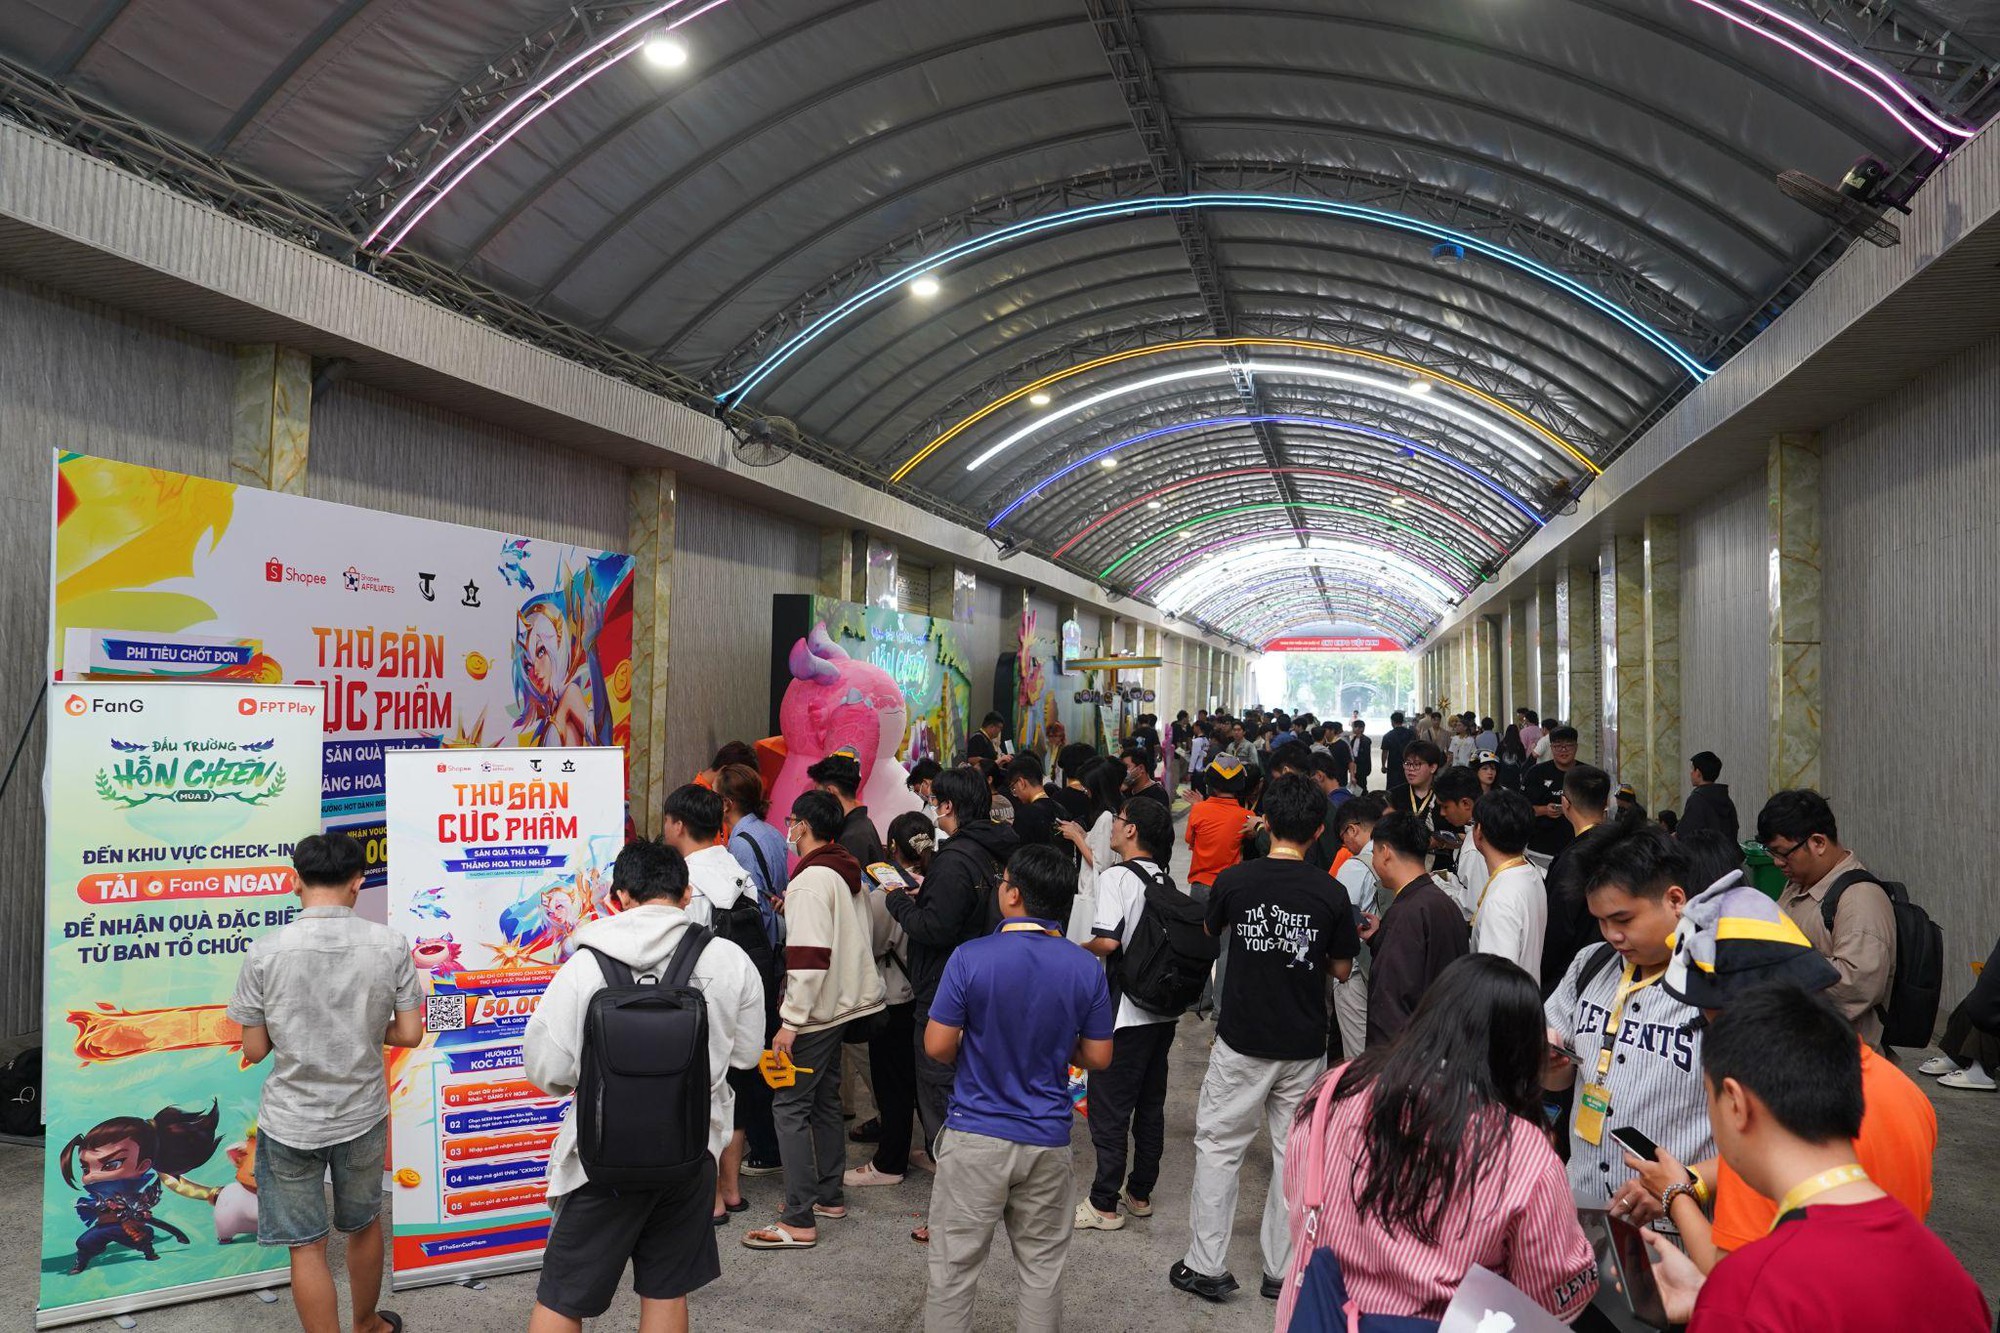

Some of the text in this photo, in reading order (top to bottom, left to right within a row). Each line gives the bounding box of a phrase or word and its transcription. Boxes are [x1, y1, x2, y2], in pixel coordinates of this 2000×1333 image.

[286, 567, 326, 587] Shopee
[361, 573, 380, 582] Shopee
[361, 582, 395, 594] AFFILIATES
[127, 645, 238, 663] PHI TIÊU CHỐT ĐƠN
[312, 625, 444, 678] THỢ SĂN
[92, 699, 144, 713] FanG
[260, 702, 315, 716] FPT Play
[374, 682, 452, 731] PHẨM
[152, 736, 237, 752] ĐẤU TRƯỜNG
[326, 745, 352, 763] SĂN
[355, 743, 382, 761] QUÀ
[113, 755, 277, 789] HỖN CHIẾN
[354, 774, 382, 790] HOA
[452, 778, 568, 810] THỢ SĂN
[438, 810, 577, 844] CỰC PHẨM
[83, 843, 295, 864] ĐẾN KHU VỰC CHECK-IN
[492, 847, 509, 857] QUÀ
[492, 860, 509, 868] HOA
[511, 859, 527, 868] THU
[529, 859, 551, 868] NHẬP
[95, 873, 287, 900] TẢI FanG NGAY
[64, 913, 95, 938] ĐỂ
[100, 914, 164, 938] NHẬN
[169, 910, 213, 931] QUÀ
[217, 909, 260, 931] ĐẶC
[1270, 905, 1311, 927] STREET
[78, 932, 253, 964] TỪ BAN TỔ CHỨC
[471, 1060, 493, 1070] KOC
[451, 1175, 462, 1183] 04
